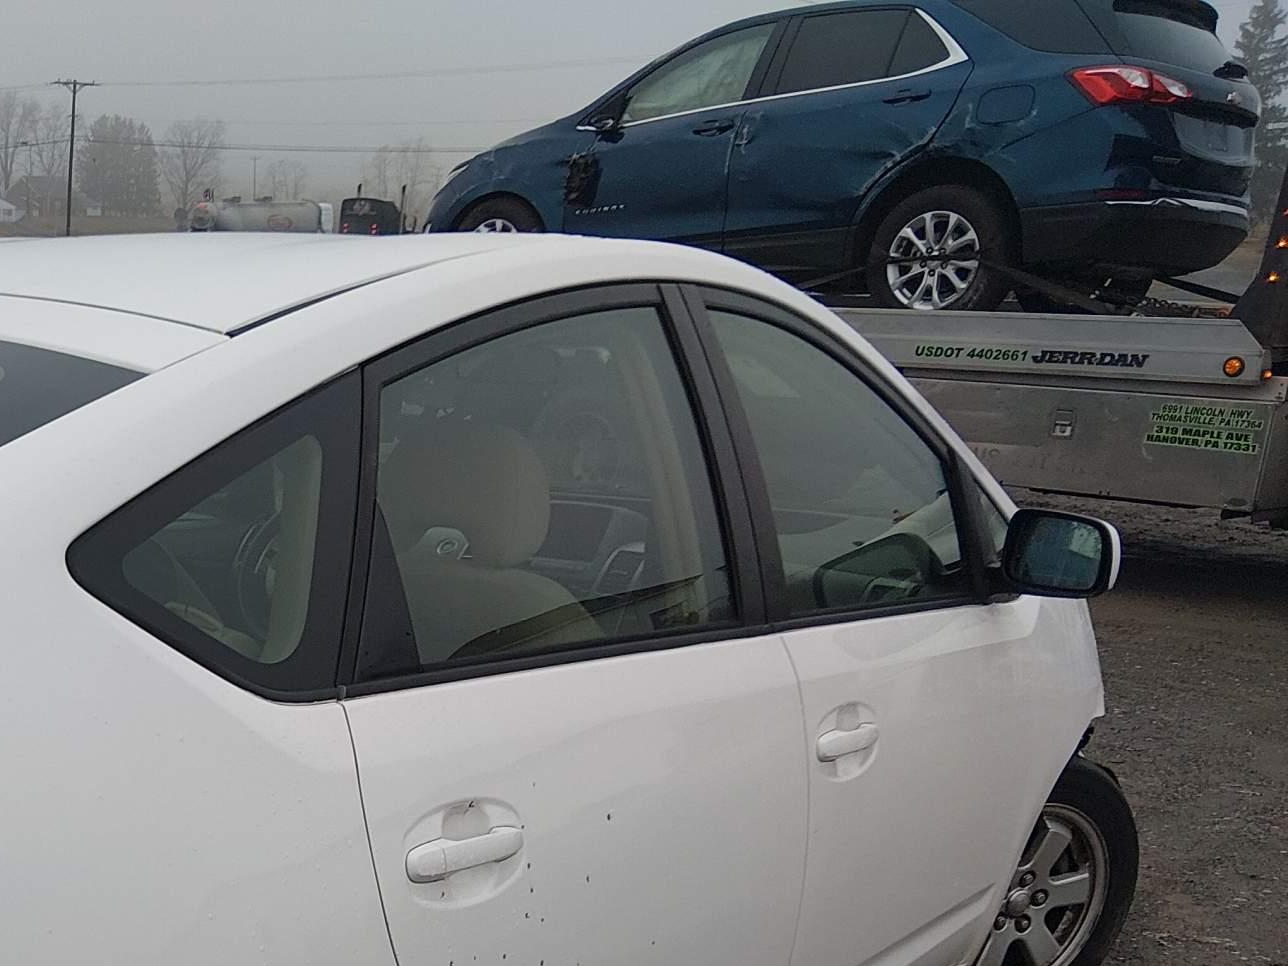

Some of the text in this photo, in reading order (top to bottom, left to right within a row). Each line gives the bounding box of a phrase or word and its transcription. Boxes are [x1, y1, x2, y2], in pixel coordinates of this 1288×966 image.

[915, 345, 1028, 361] USDOT 4402661
[1161, 404, 1253, 419] 6991 LINCOLN HWY
[1219, 419, 1231, 427] PA
[1234, 420, 1263, 429] 17364
[1155, 425, 1252, 442] 319 MAPLE AVE
[1204, 440, 1220, 449] PA
[1223, 441, 1257, 453] 17331
